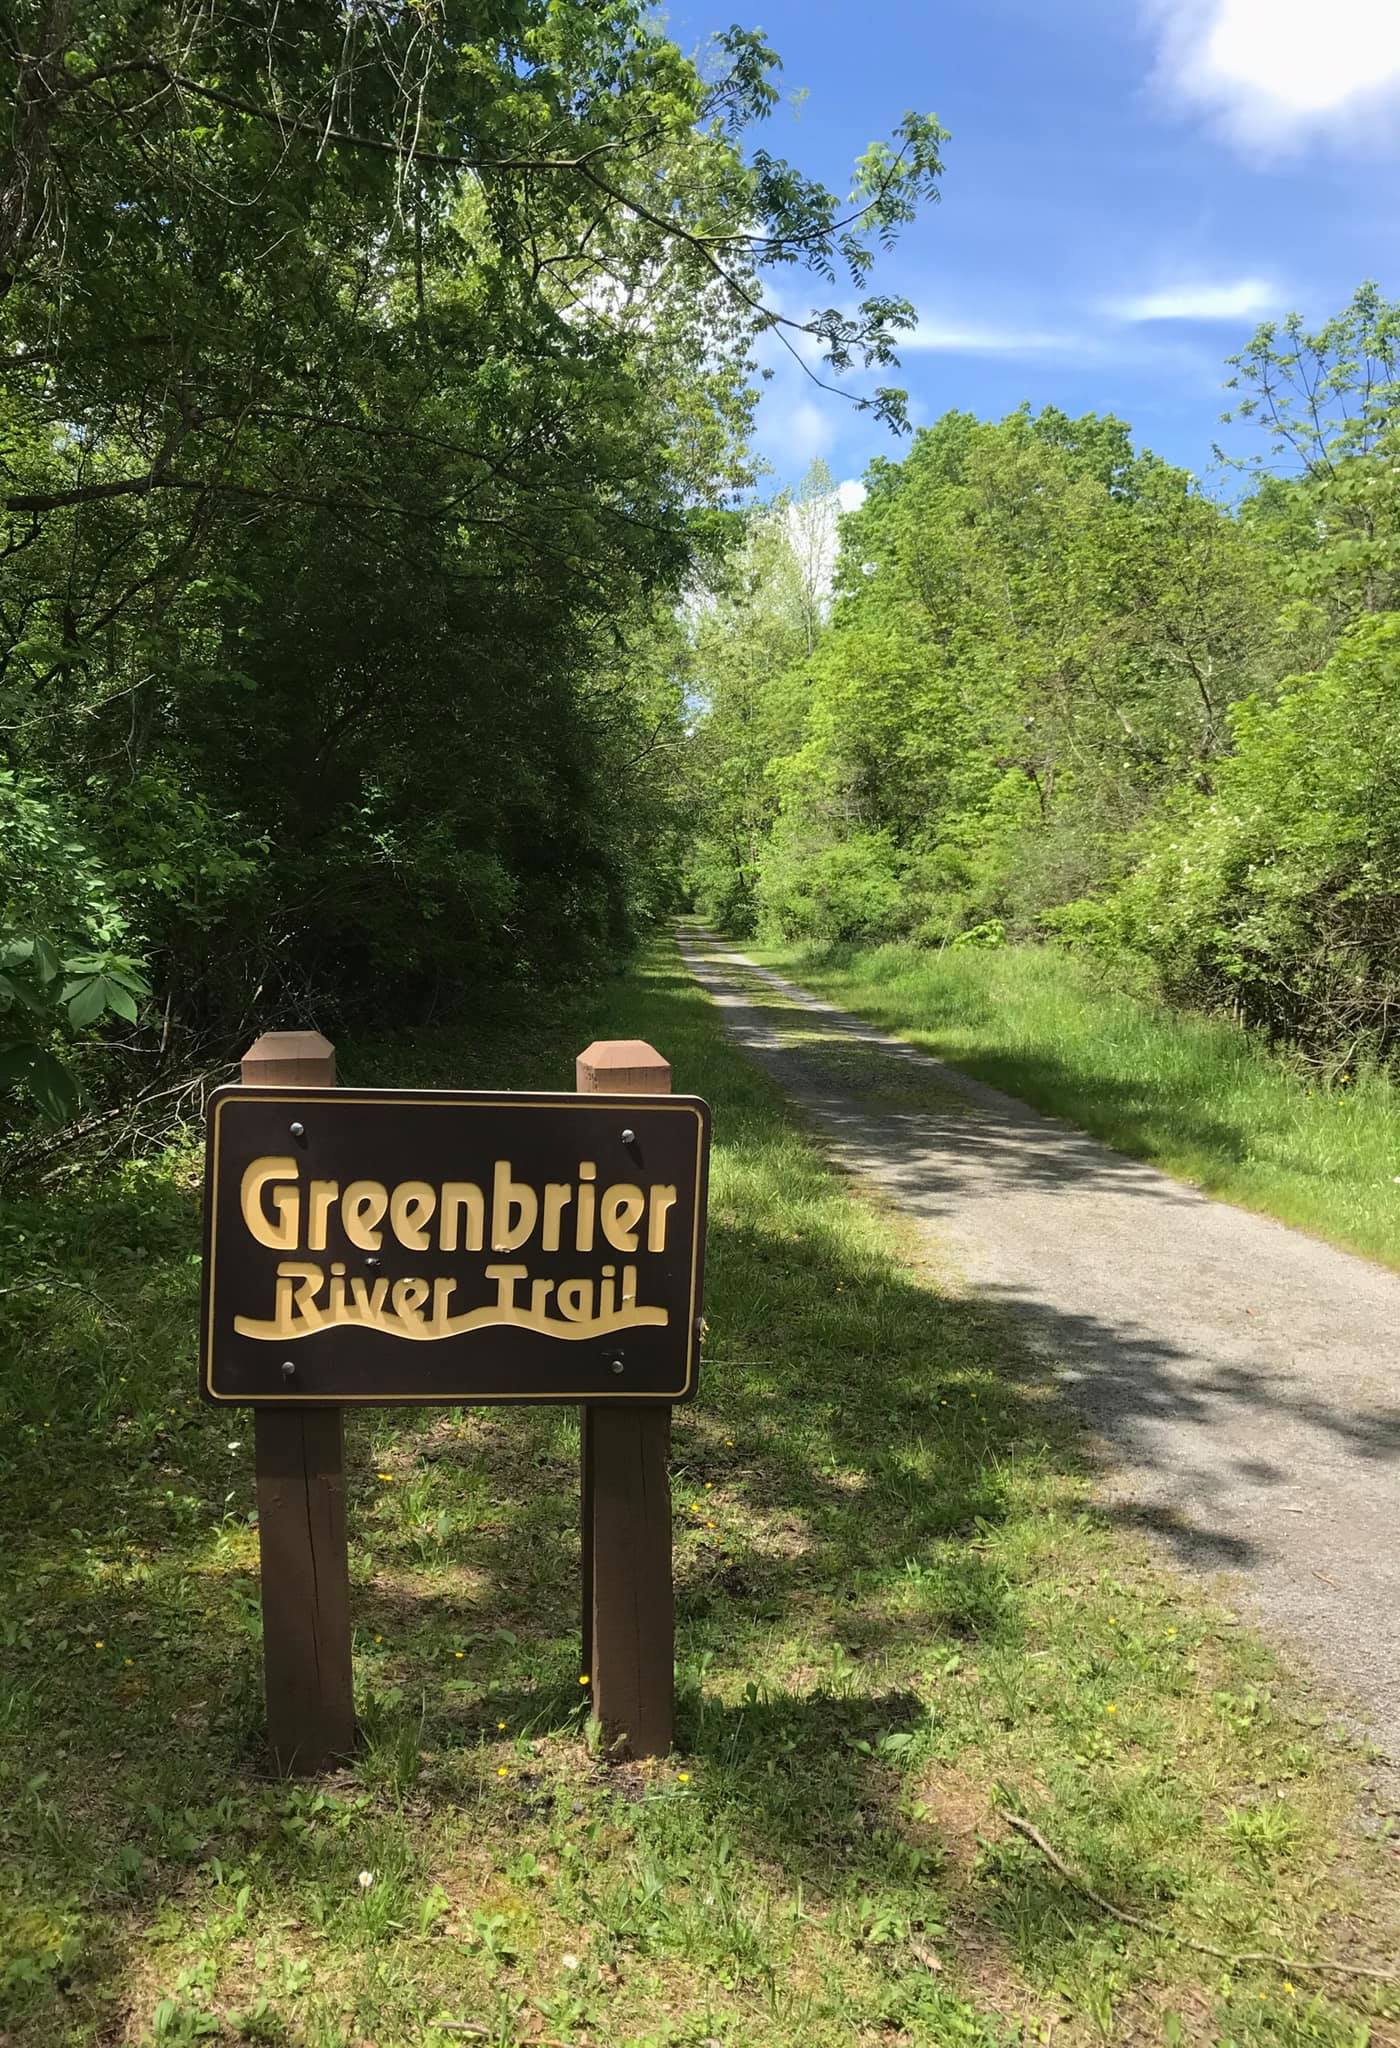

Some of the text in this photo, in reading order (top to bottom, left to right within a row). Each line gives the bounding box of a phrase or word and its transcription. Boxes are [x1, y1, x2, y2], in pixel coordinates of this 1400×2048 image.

[240, 1155, 677, 1253] Greenbrier
[275, 1261, 638, 1336] River Trail
